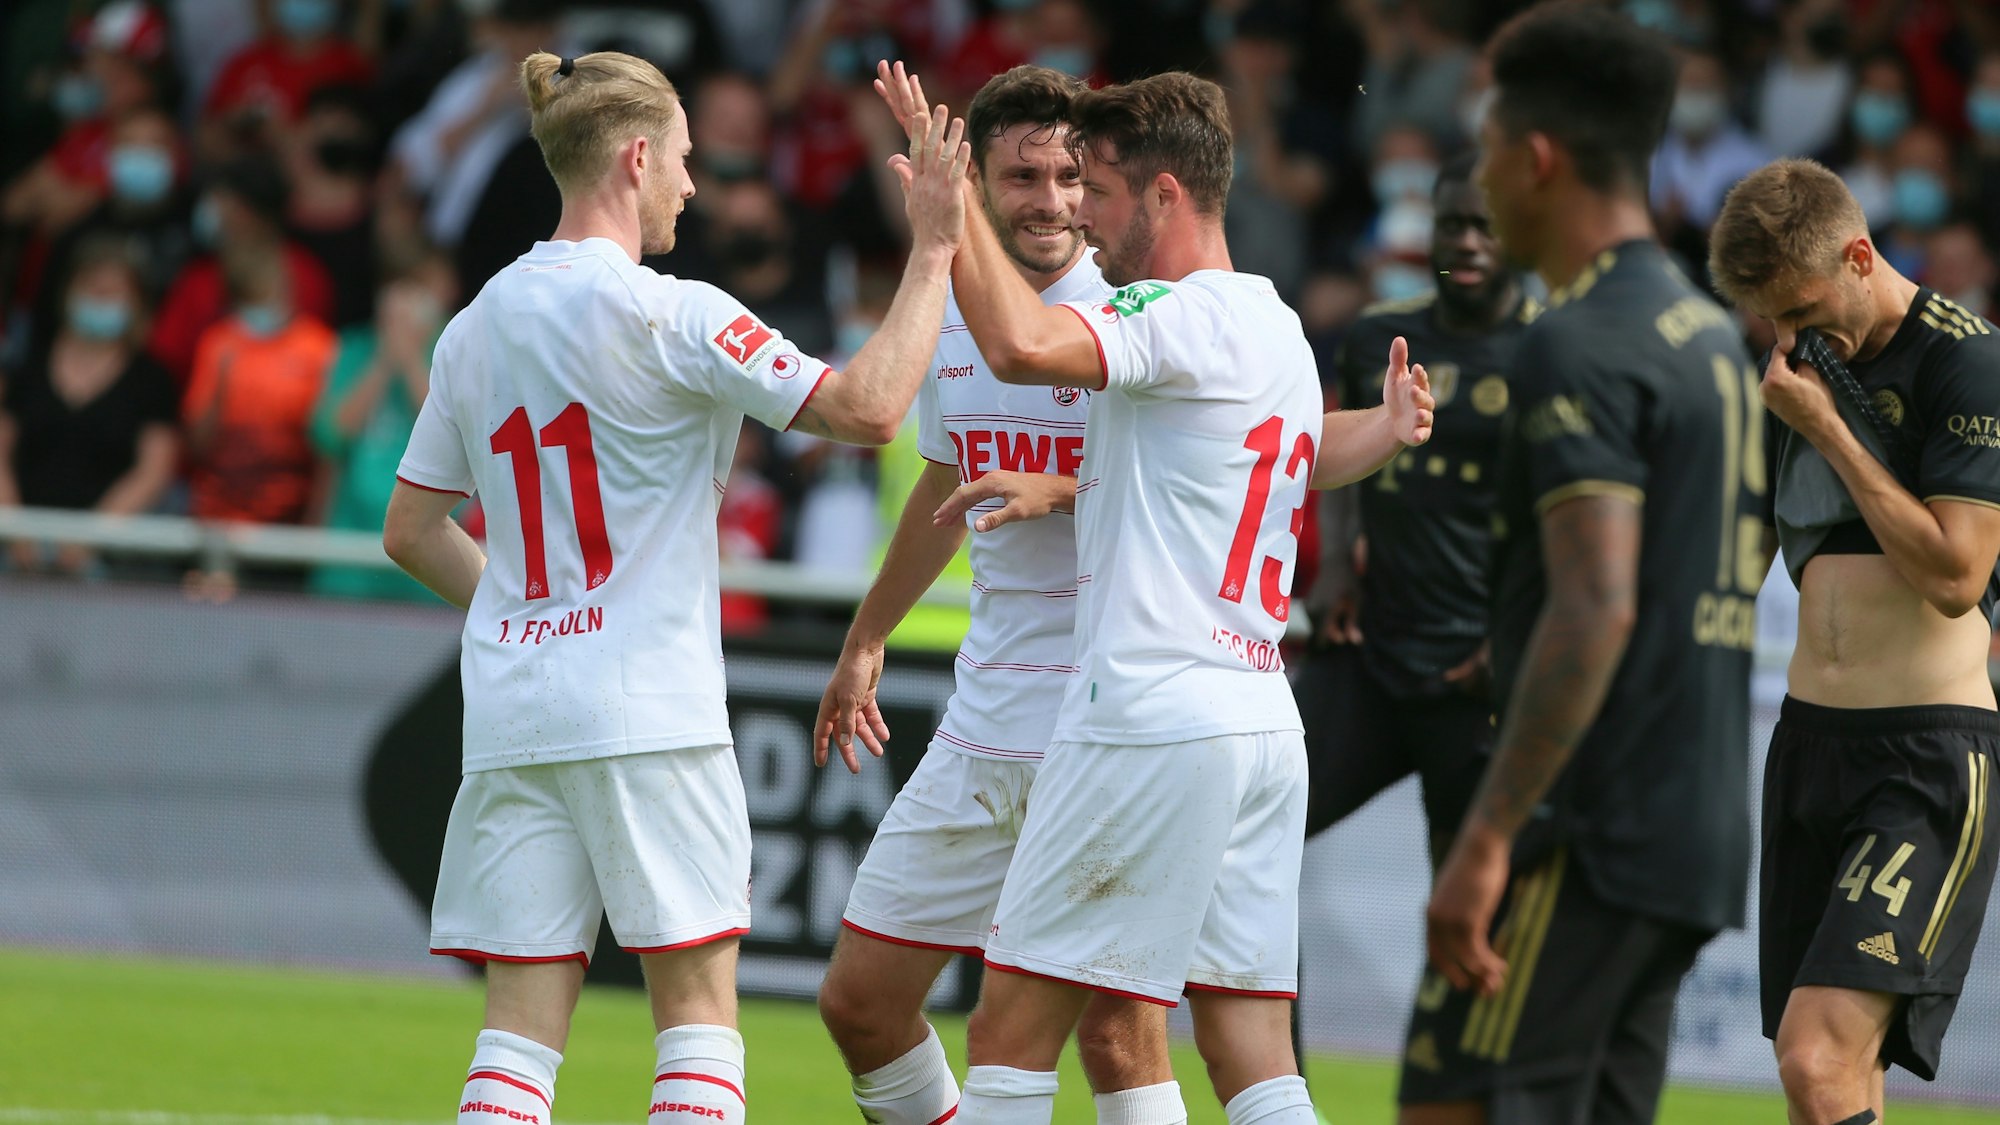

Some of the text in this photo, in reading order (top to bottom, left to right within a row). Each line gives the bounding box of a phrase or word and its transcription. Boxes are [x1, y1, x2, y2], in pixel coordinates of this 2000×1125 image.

[937, 363, 974, 380] uhlsport
[490, 402, 613, 601] 11
[1218, 415, 1315, 623] 13
[1838, 834, 1917, 917] 44
[1857, 941, 1900, 965] adidas
[460, 1101, 540, 1125] uhlsport
